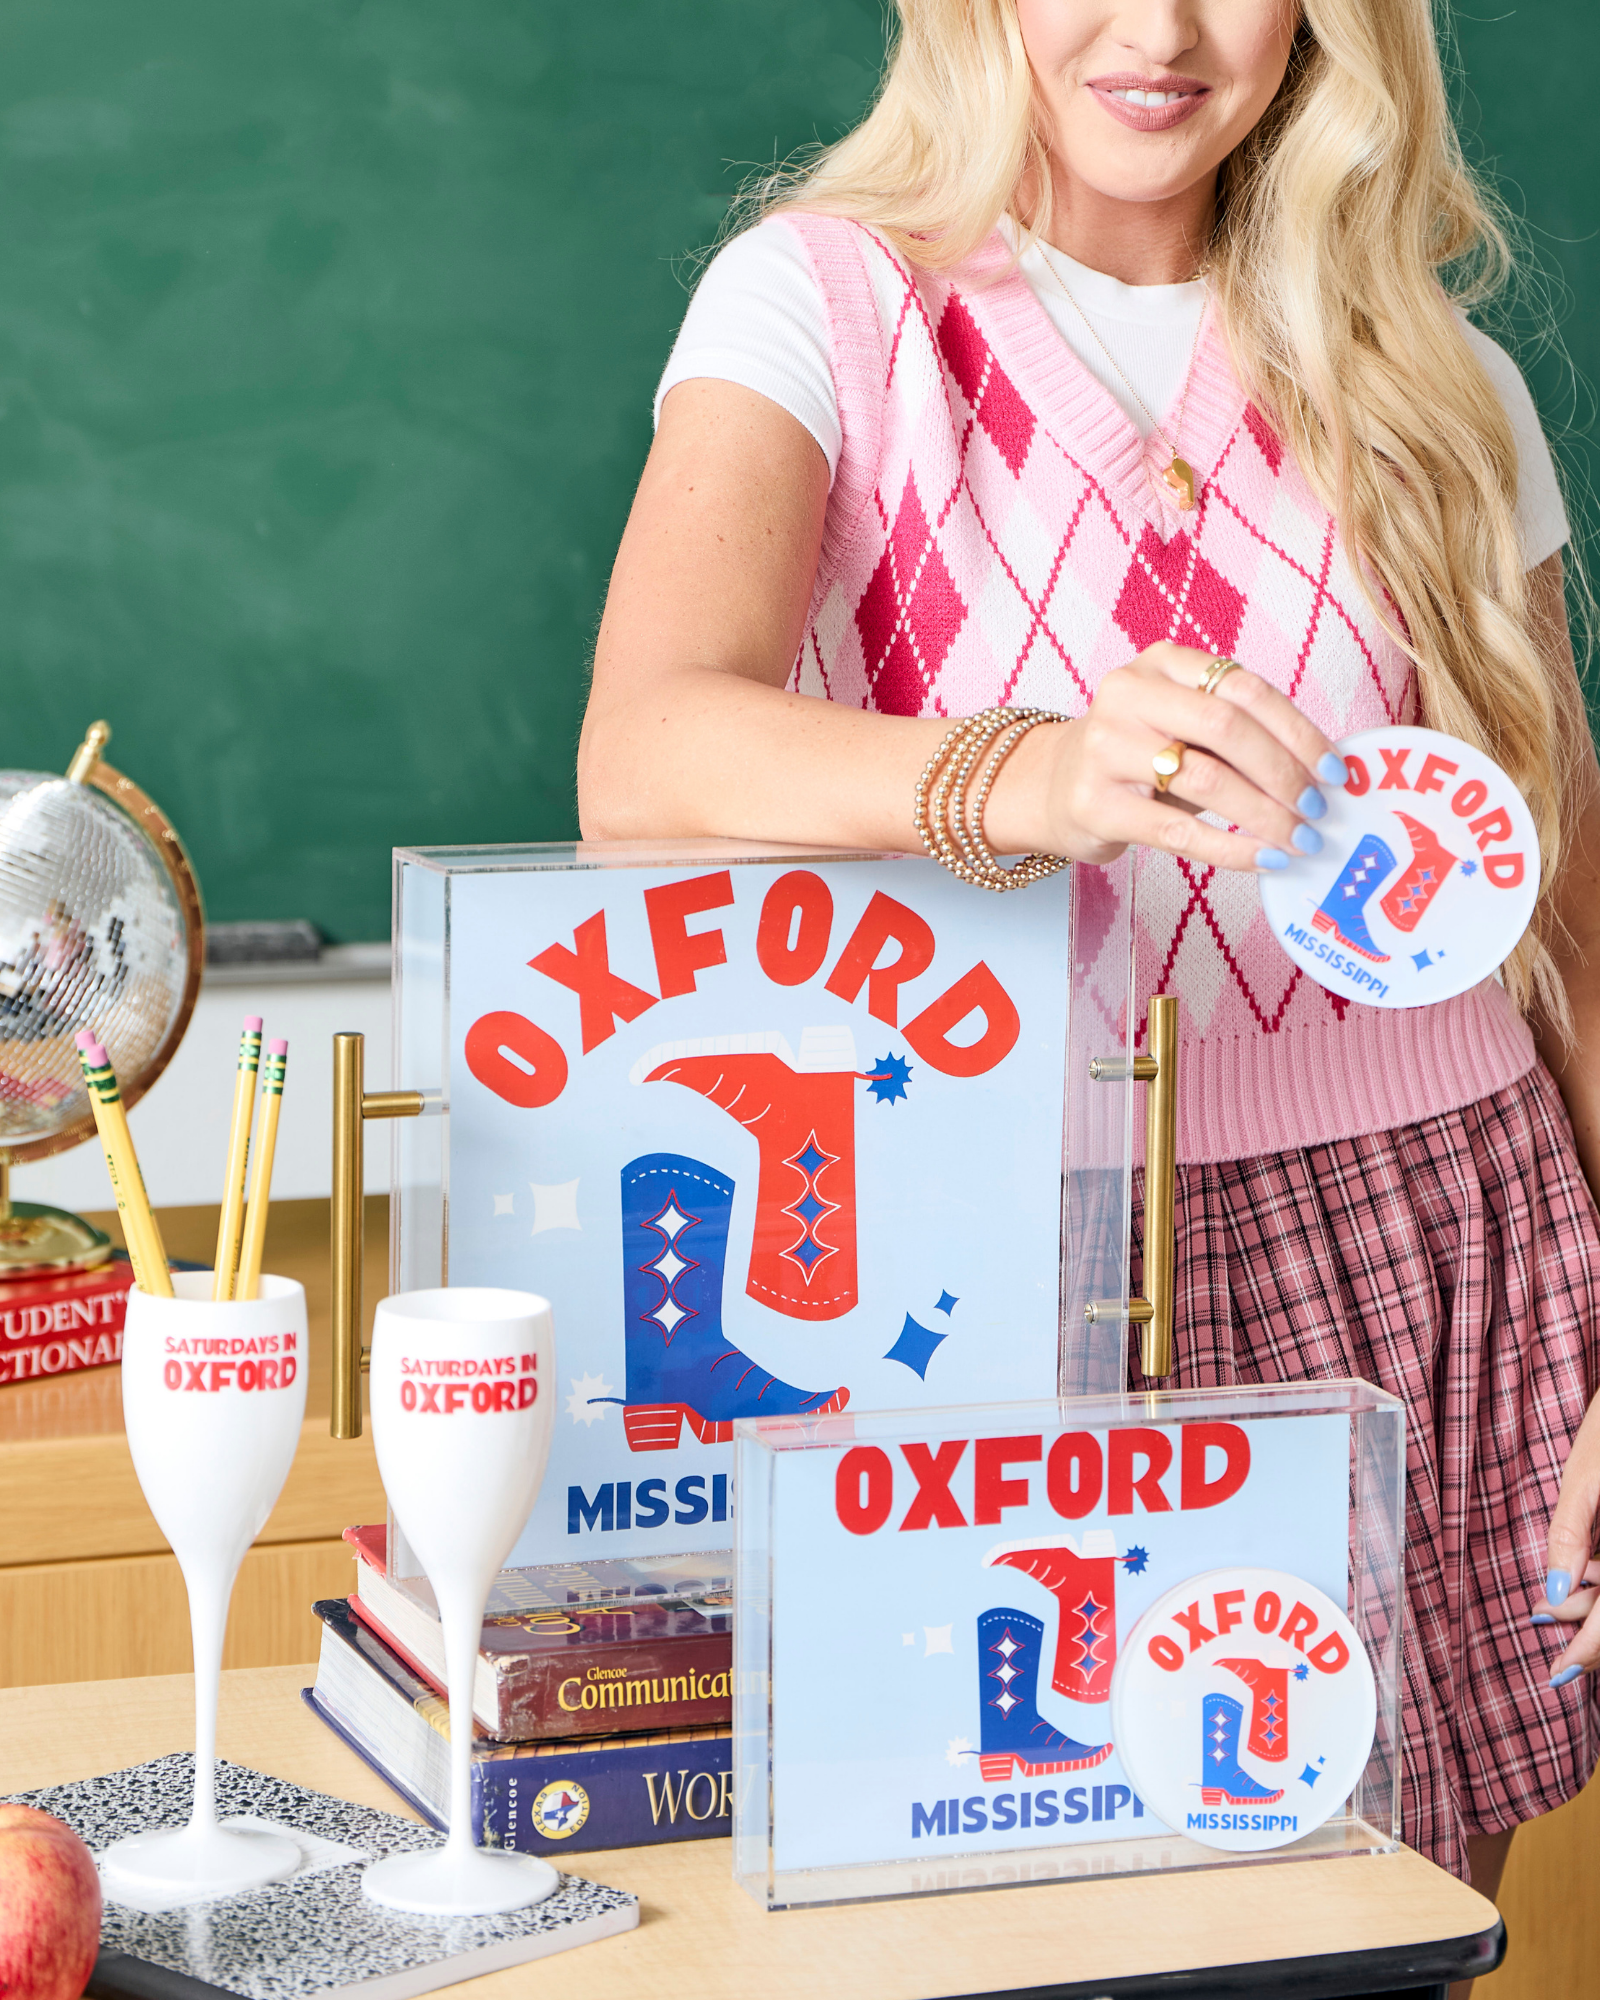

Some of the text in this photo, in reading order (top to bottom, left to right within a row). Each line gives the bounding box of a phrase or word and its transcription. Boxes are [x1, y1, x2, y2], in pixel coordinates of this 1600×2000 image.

[1343, 748, 1525, 889] OXFORD
[1284, 923, 1389, 999] MISSISSIPPI
[465, 870, 1020, 1108] OXFORD
[164, 1332, 297, 1355] SATURDAYS IN
[401, 1353, 537, 1377] SATURDAYS IN
[164, 1356, 297, 1392] OXFORD
[401, 1377, 538, 1414] OXFORD
[835, 1421, 1251, 1536] OXFORD
[567, 1473, 734, 1535] MISSI
[1148, 1589, 1350, 1674] OXFORD
[587, 1666, 628, 1681] Glencoe
[504, 1778, 518, 1851] Glencoe
[533, 1791, 548, 1833] TEXAS
[569, 1784, 589, 1833] EDITION
[1187, 1813, 1297, 1832] MISSISSIPPI
